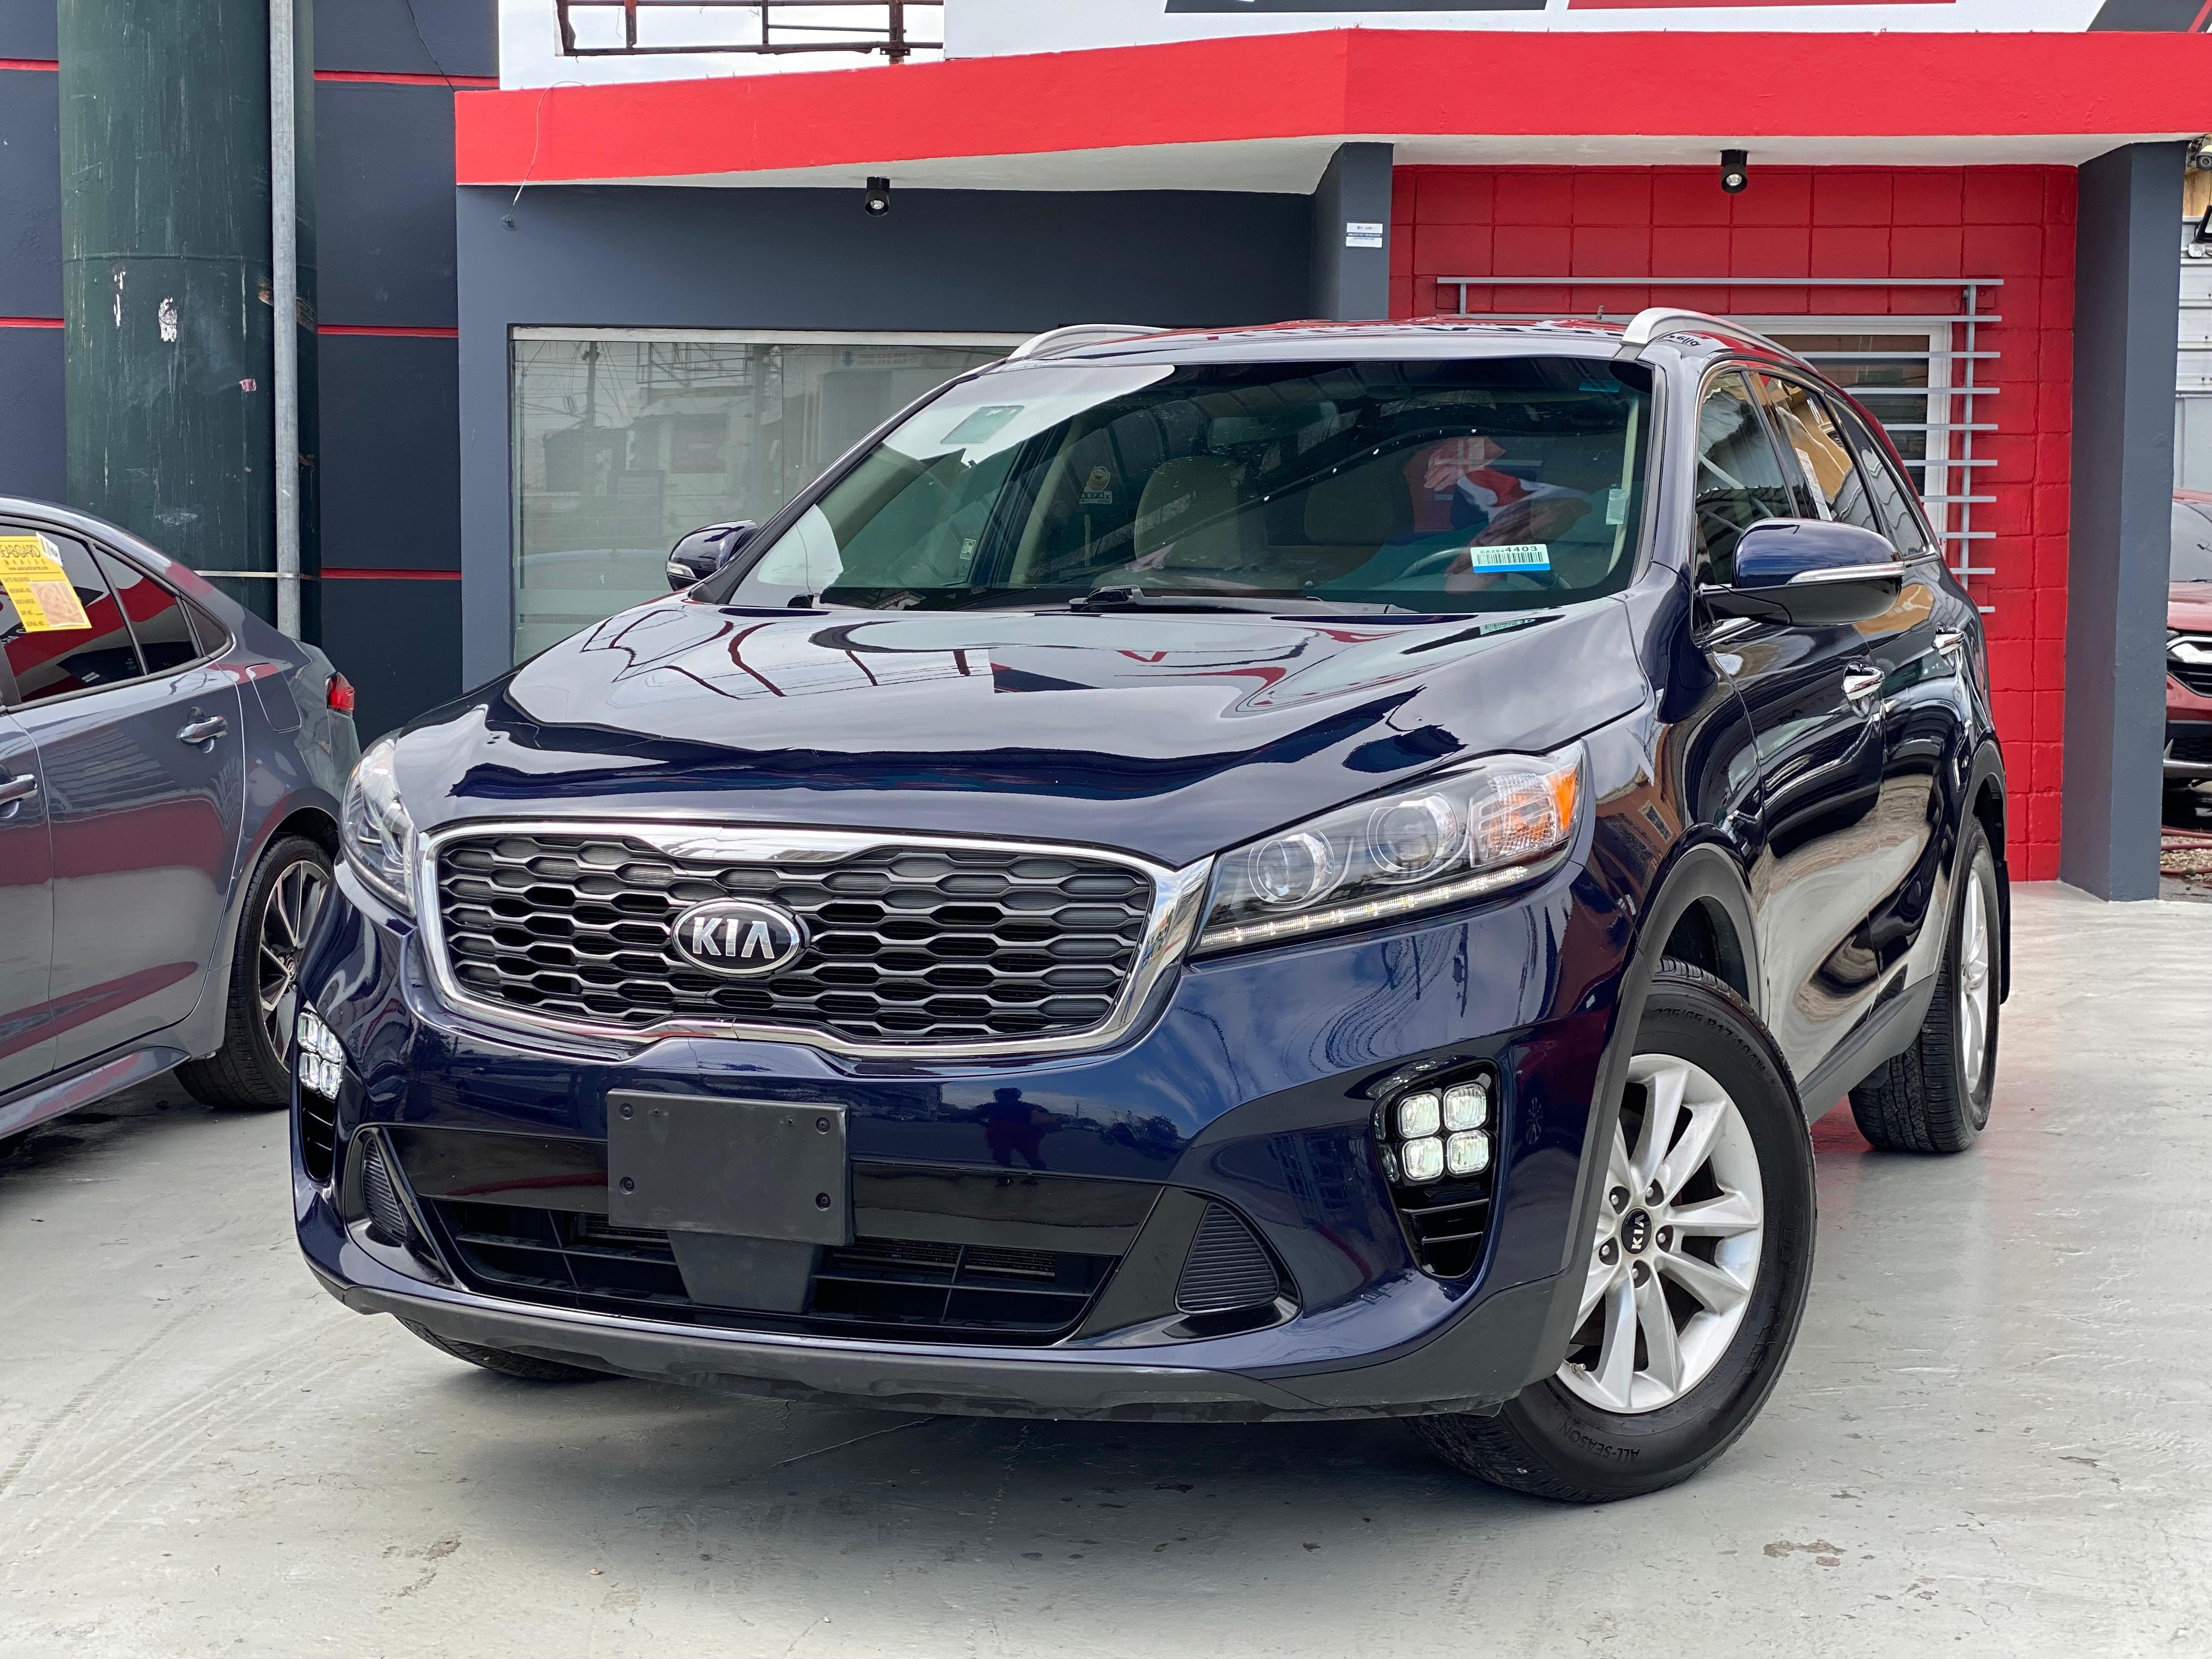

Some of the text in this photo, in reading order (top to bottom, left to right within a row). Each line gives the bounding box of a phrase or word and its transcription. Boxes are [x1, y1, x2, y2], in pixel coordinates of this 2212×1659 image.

[692, 917, 775, 959] KIA
[1631, 1214, 1645, 1250] KIA
[1558, 1422, 1640, 1462] ALL-SEASON
